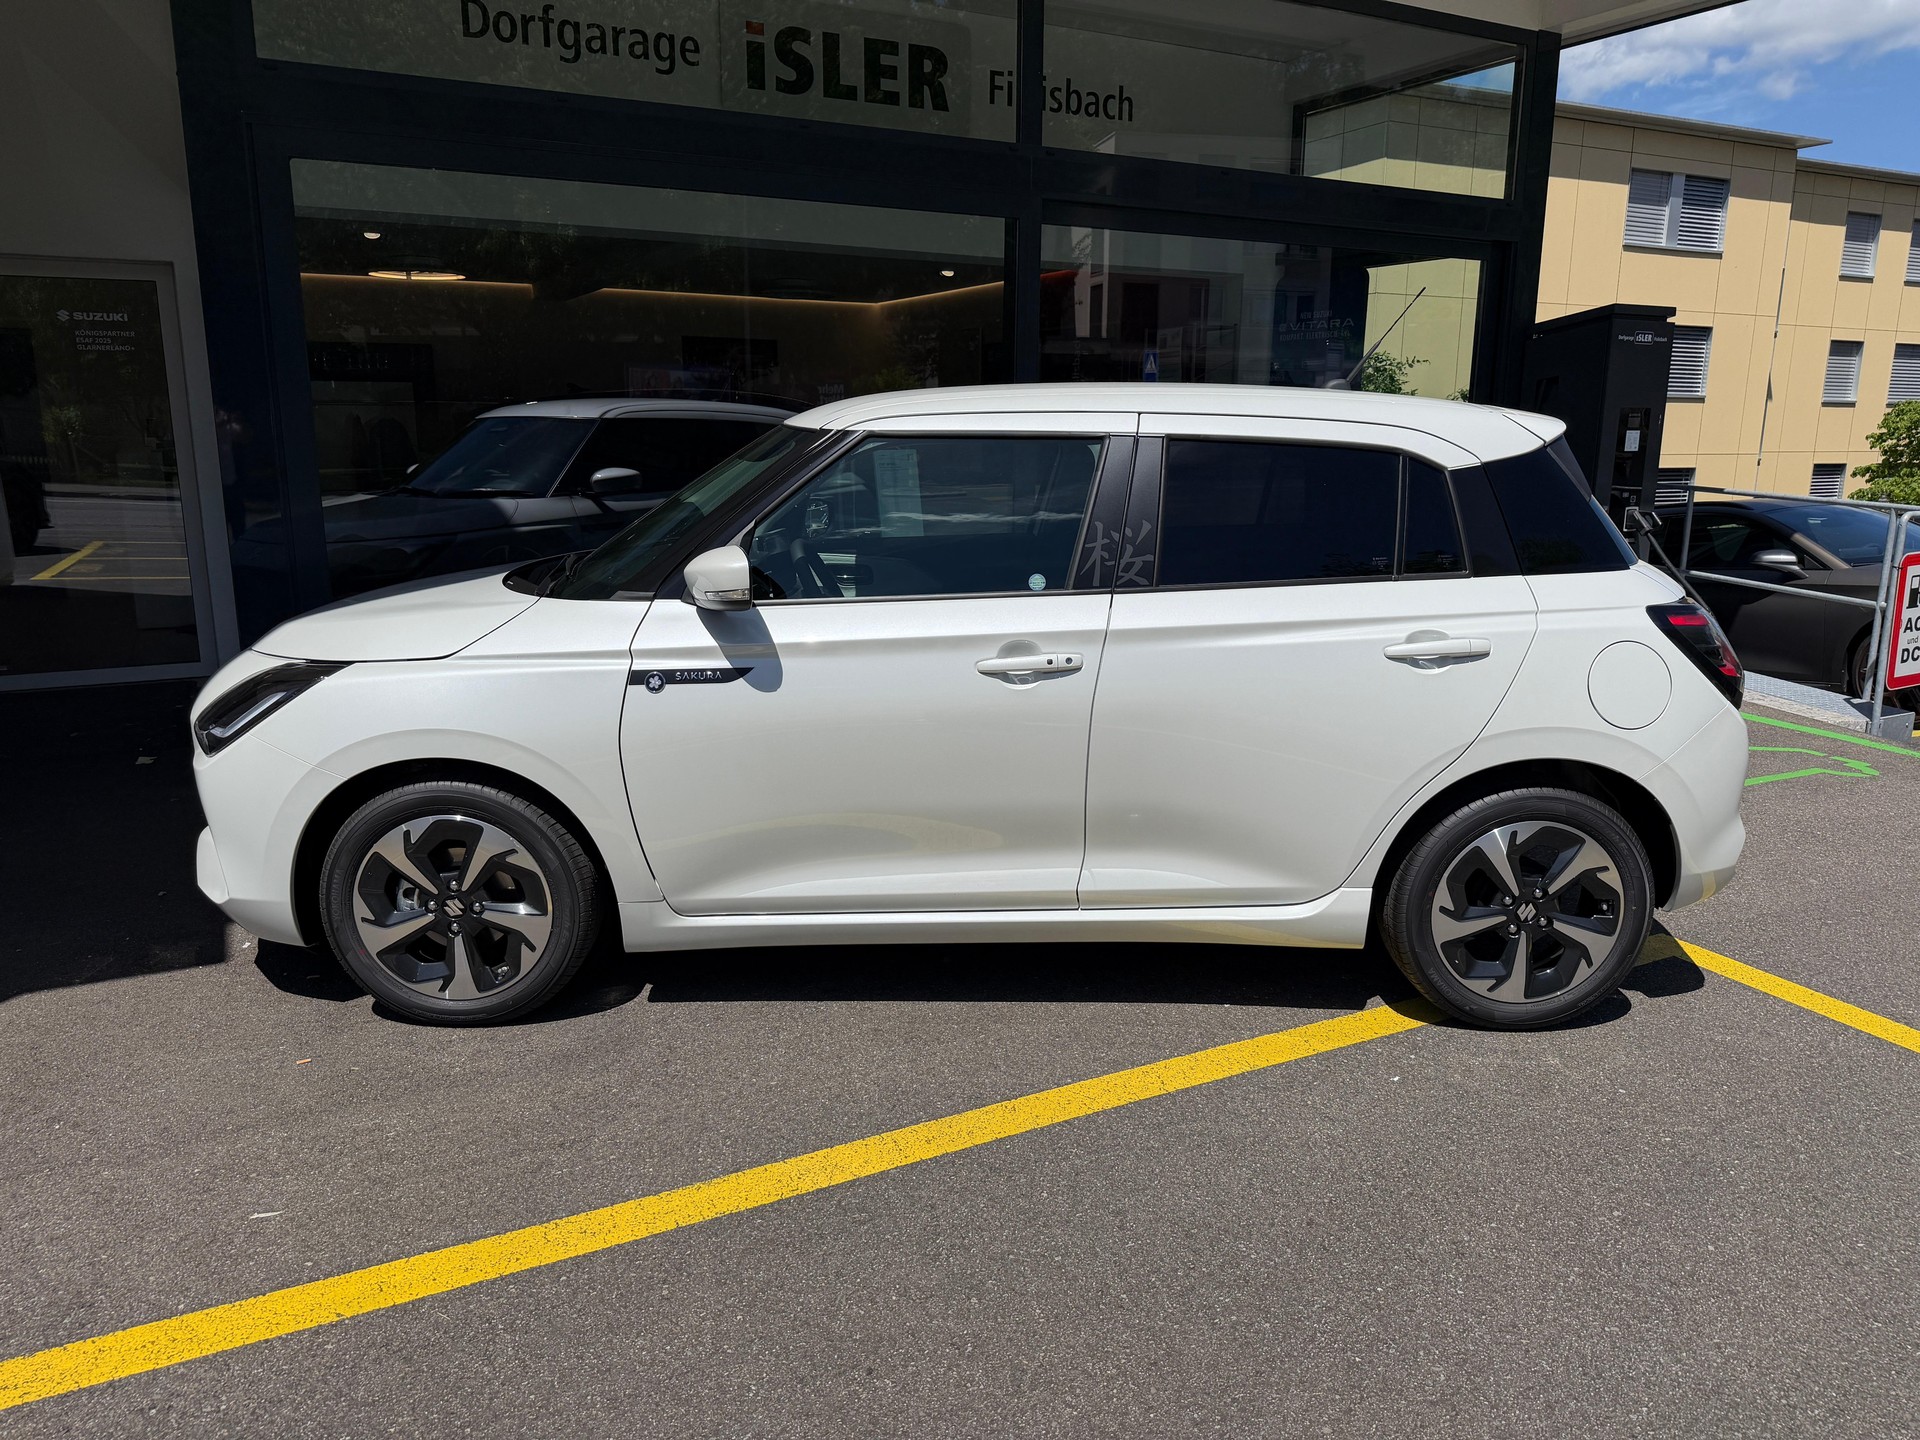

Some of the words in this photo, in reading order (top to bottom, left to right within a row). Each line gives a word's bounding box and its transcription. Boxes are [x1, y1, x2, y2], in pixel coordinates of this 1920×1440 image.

[461, 0, 701, 75] Dorfgarage
[72, 312, 128, 321] SUZUKI
[1290, 318, 1354, 331] VITARA
[75, 329, 135, 337] KÖNIGSPARTNER
[1080, 519, 1154, 587] 桜
[1907, 636, 1919, 645] und
[1900, 646, 1920, 664] DC
[675, 671, 722, 681] SAKURA
